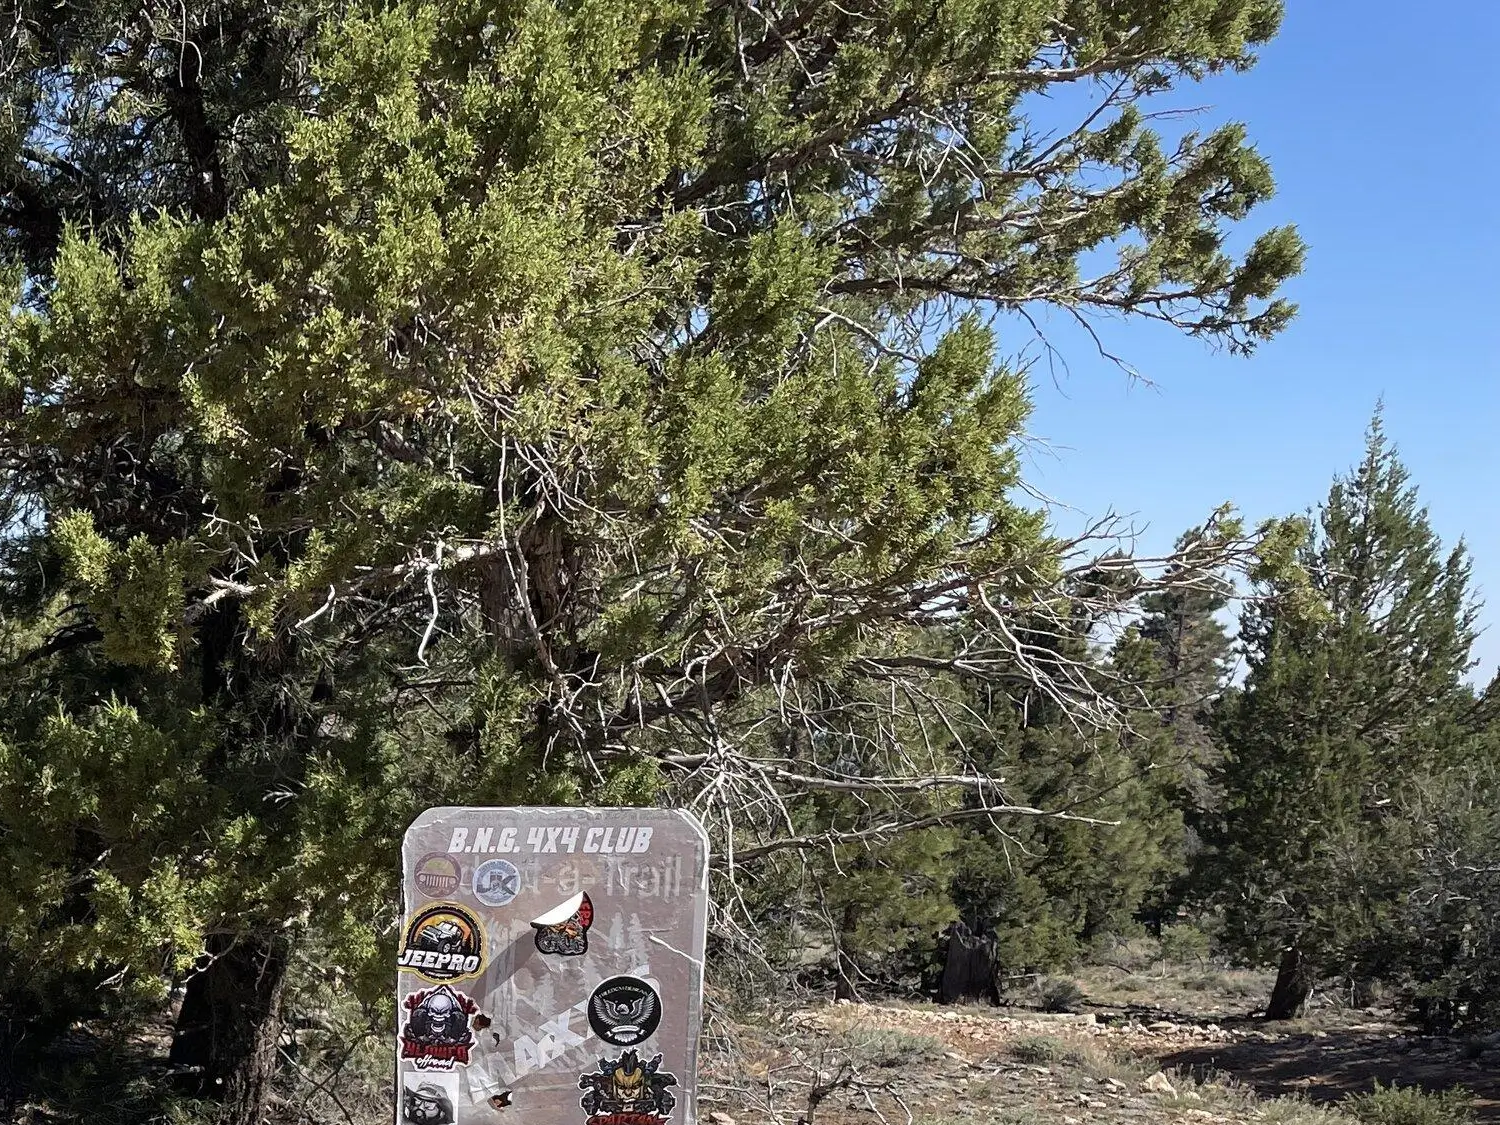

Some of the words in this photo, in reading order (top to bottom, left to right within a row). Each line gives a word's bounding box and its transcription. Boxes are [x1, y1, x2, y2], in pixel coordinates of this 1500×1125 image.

[448, 827, 520, 853] B.N.G.
[527, 827, 579, 853] 4X4
[583, 827, 653, 853] CLUB
[398, 949, 479, 972] JEEPRO
